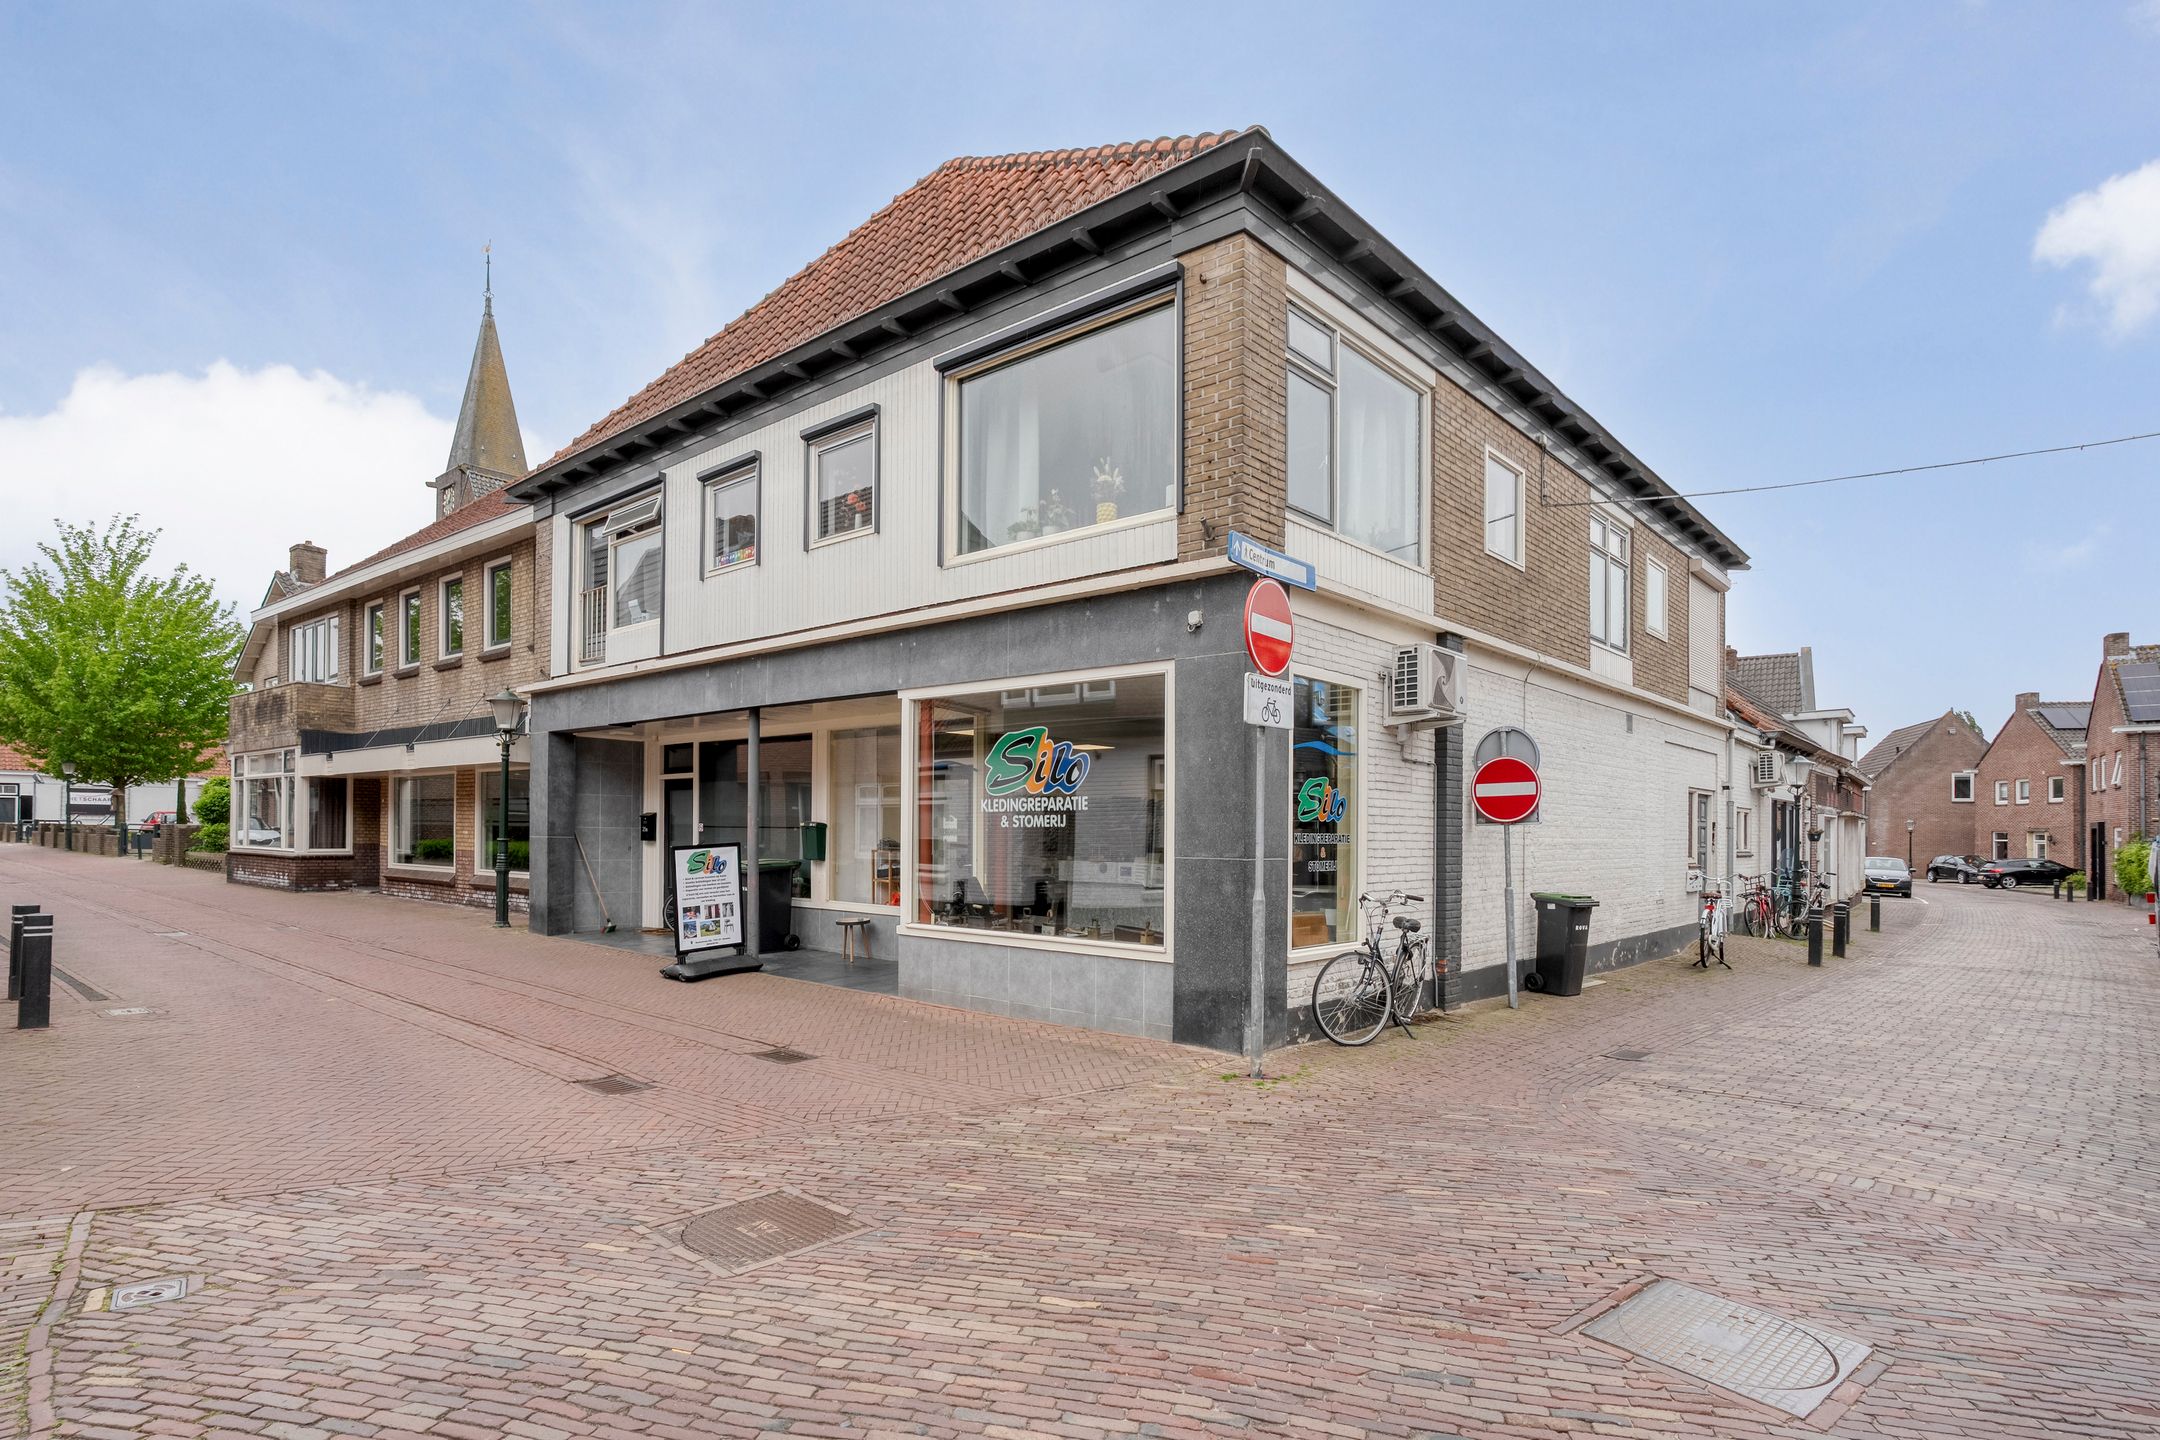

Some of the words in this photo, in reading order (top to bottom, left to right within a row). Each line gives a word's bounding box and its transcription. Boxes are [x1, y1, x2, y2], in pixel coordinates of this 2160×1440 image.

[1248, 548, 1276, 571] Centrum
[1251, 677, 1292, 696] Uitgezonderd
[986, 729, 1088, 793] Silo
[981, 796, 1089, 813] KLEDINGREPARATIE
[1298, 778, 1347, 821] Silo
[1000, 815, 1009, 828] &
[1012, 814, 1067, 828] STOMERIJ
[1294, 832, 1350, 844] KLEDINGREPARATIE
[687, 850, 727, 874] Silo
